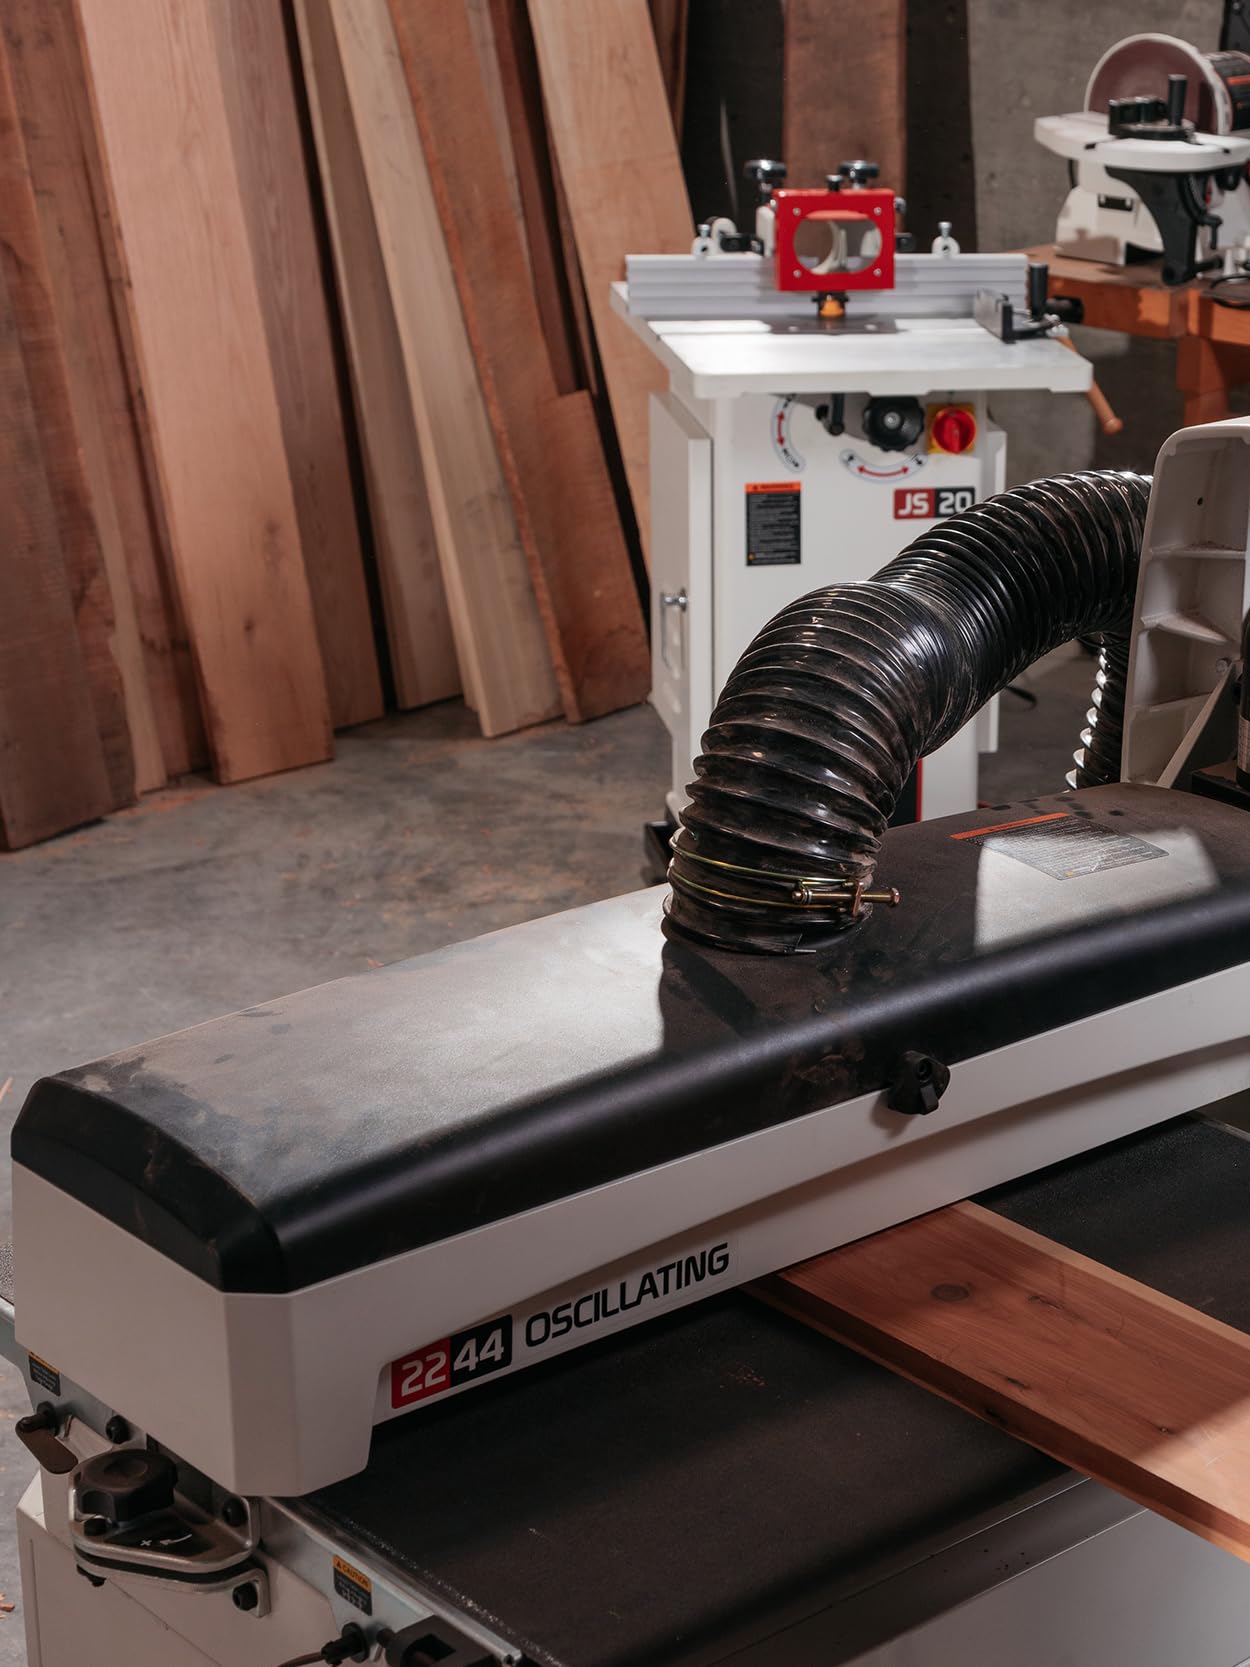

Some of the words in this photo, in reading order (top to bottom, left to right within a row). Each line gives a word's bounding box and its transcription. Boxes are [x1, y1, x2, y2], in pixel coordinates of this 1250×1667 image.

[897, 492, 930, 516] JS
[938, 491, 973, 515] 20
[525, 1242, 730, 1348] OSCILLATING
